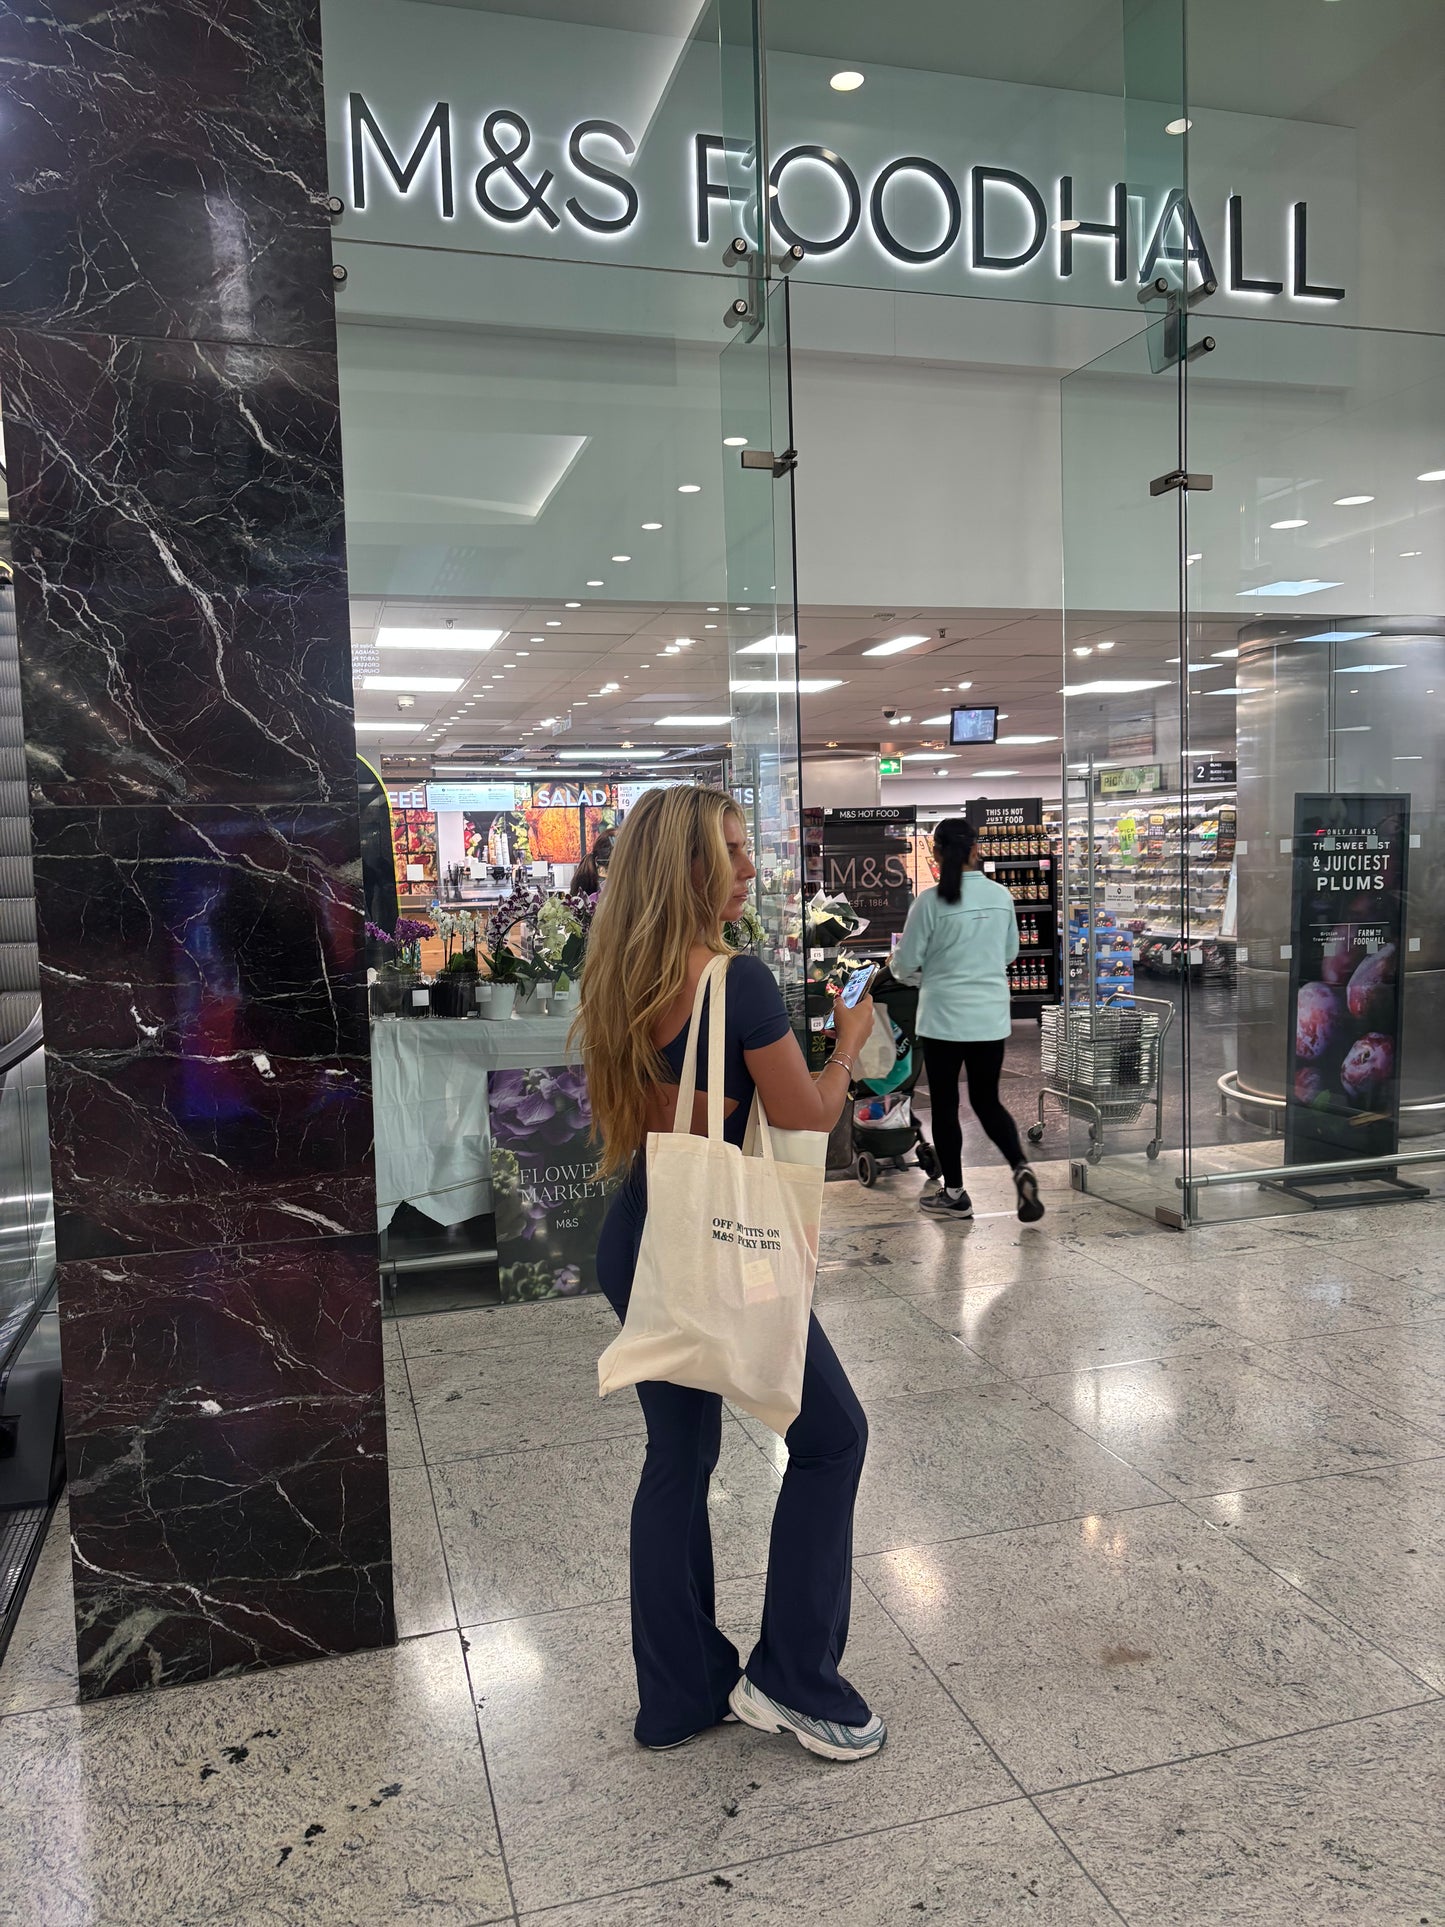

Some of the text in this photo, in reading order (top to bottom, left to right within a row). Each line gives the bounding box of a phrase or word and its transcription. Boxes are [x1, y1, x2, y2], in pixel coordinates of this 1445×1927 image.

[350, 92, 1345, 300] M&S FOODHALL
[1197, 766, 1205, 778] 2
[538, 789, 607, 807] SALAD
[858, 810, 874, 818] HOT
[876, 809, 900, 817] FOOD
[1004, 816, 1024, 824] FOOD
[1335, 841, 1391, 850] SWEEST
[1313, 855, 1391, 871] & JUICIEST
[830, 856, 905, 890] M&S
[1317, 876, 1385, 891] PLUMS
[869, 898, 889, 907] 1884
[1358, 929, 1375, 937] FARM
[519, 1180, 608, 1203] MARKET
[556, 1218, 579, 1229] M&S
[713, 1218, 733, 1230] OFF
[744, 1227, 764, 1238] TITS
[767, 1229, 780, 1239] ON
[712, 1230, 782, 1250] M&S PCKY BITS
